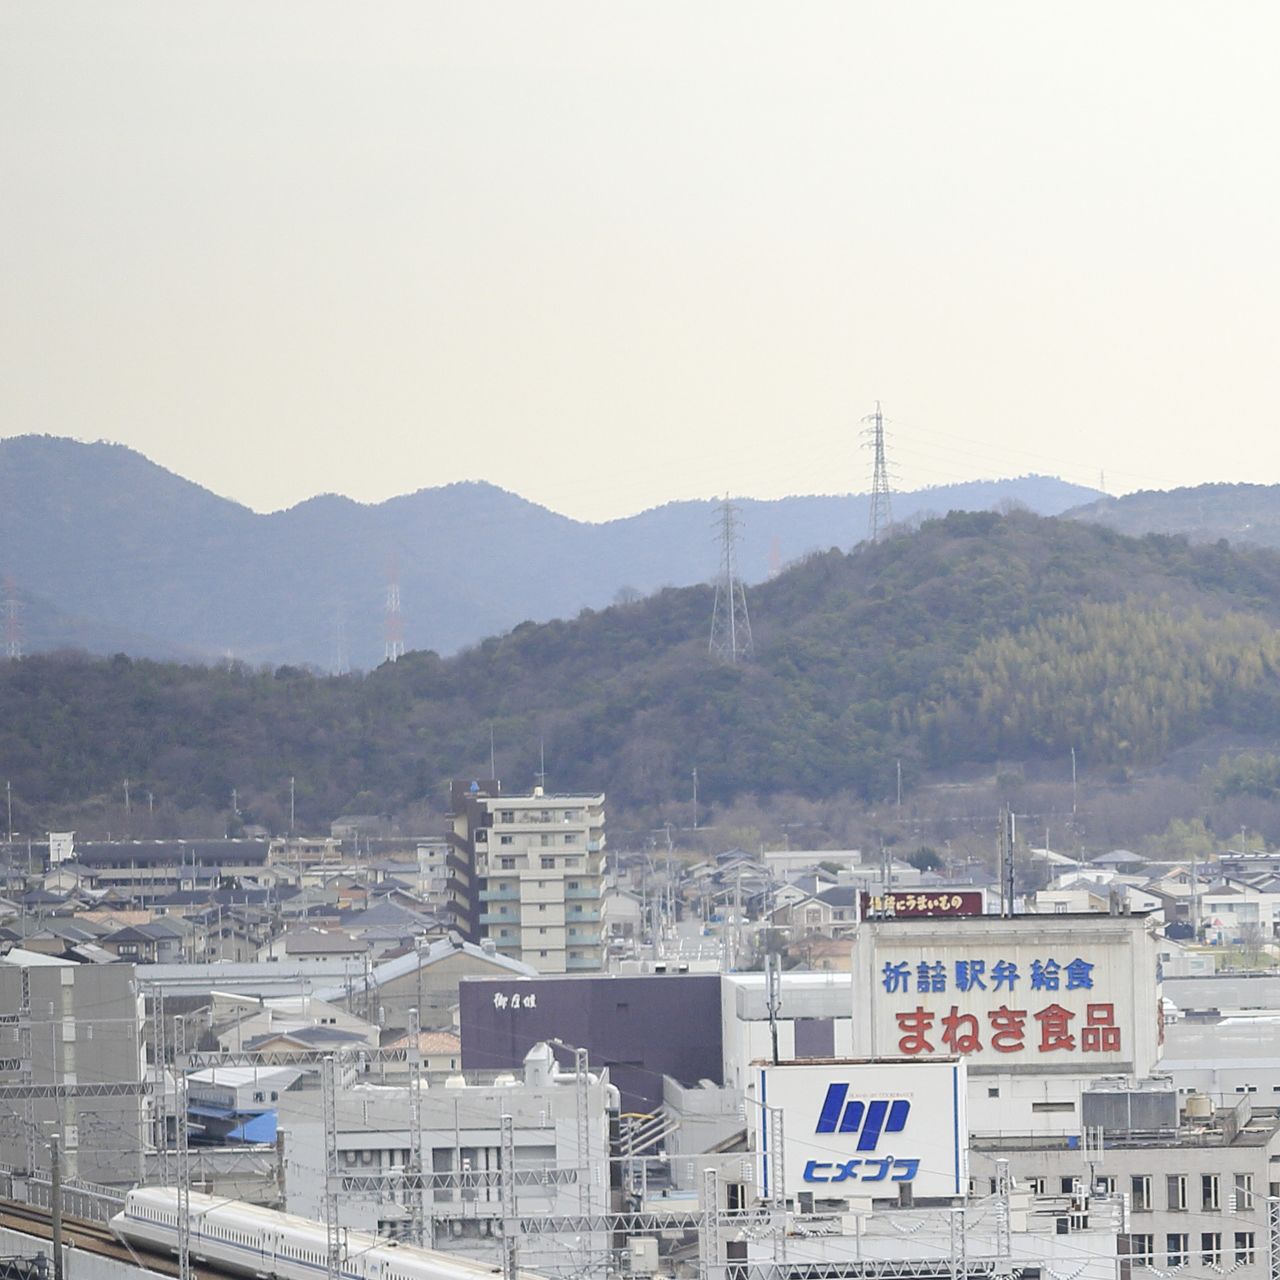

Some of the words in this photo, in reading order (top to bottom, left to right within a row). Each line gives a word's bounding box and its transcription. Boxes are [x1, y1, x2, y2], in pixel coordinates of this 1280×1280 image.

[896, 1003, 1121, 1054] まねき食品
[803, 1155, 920, 1183] ヒメプラ
